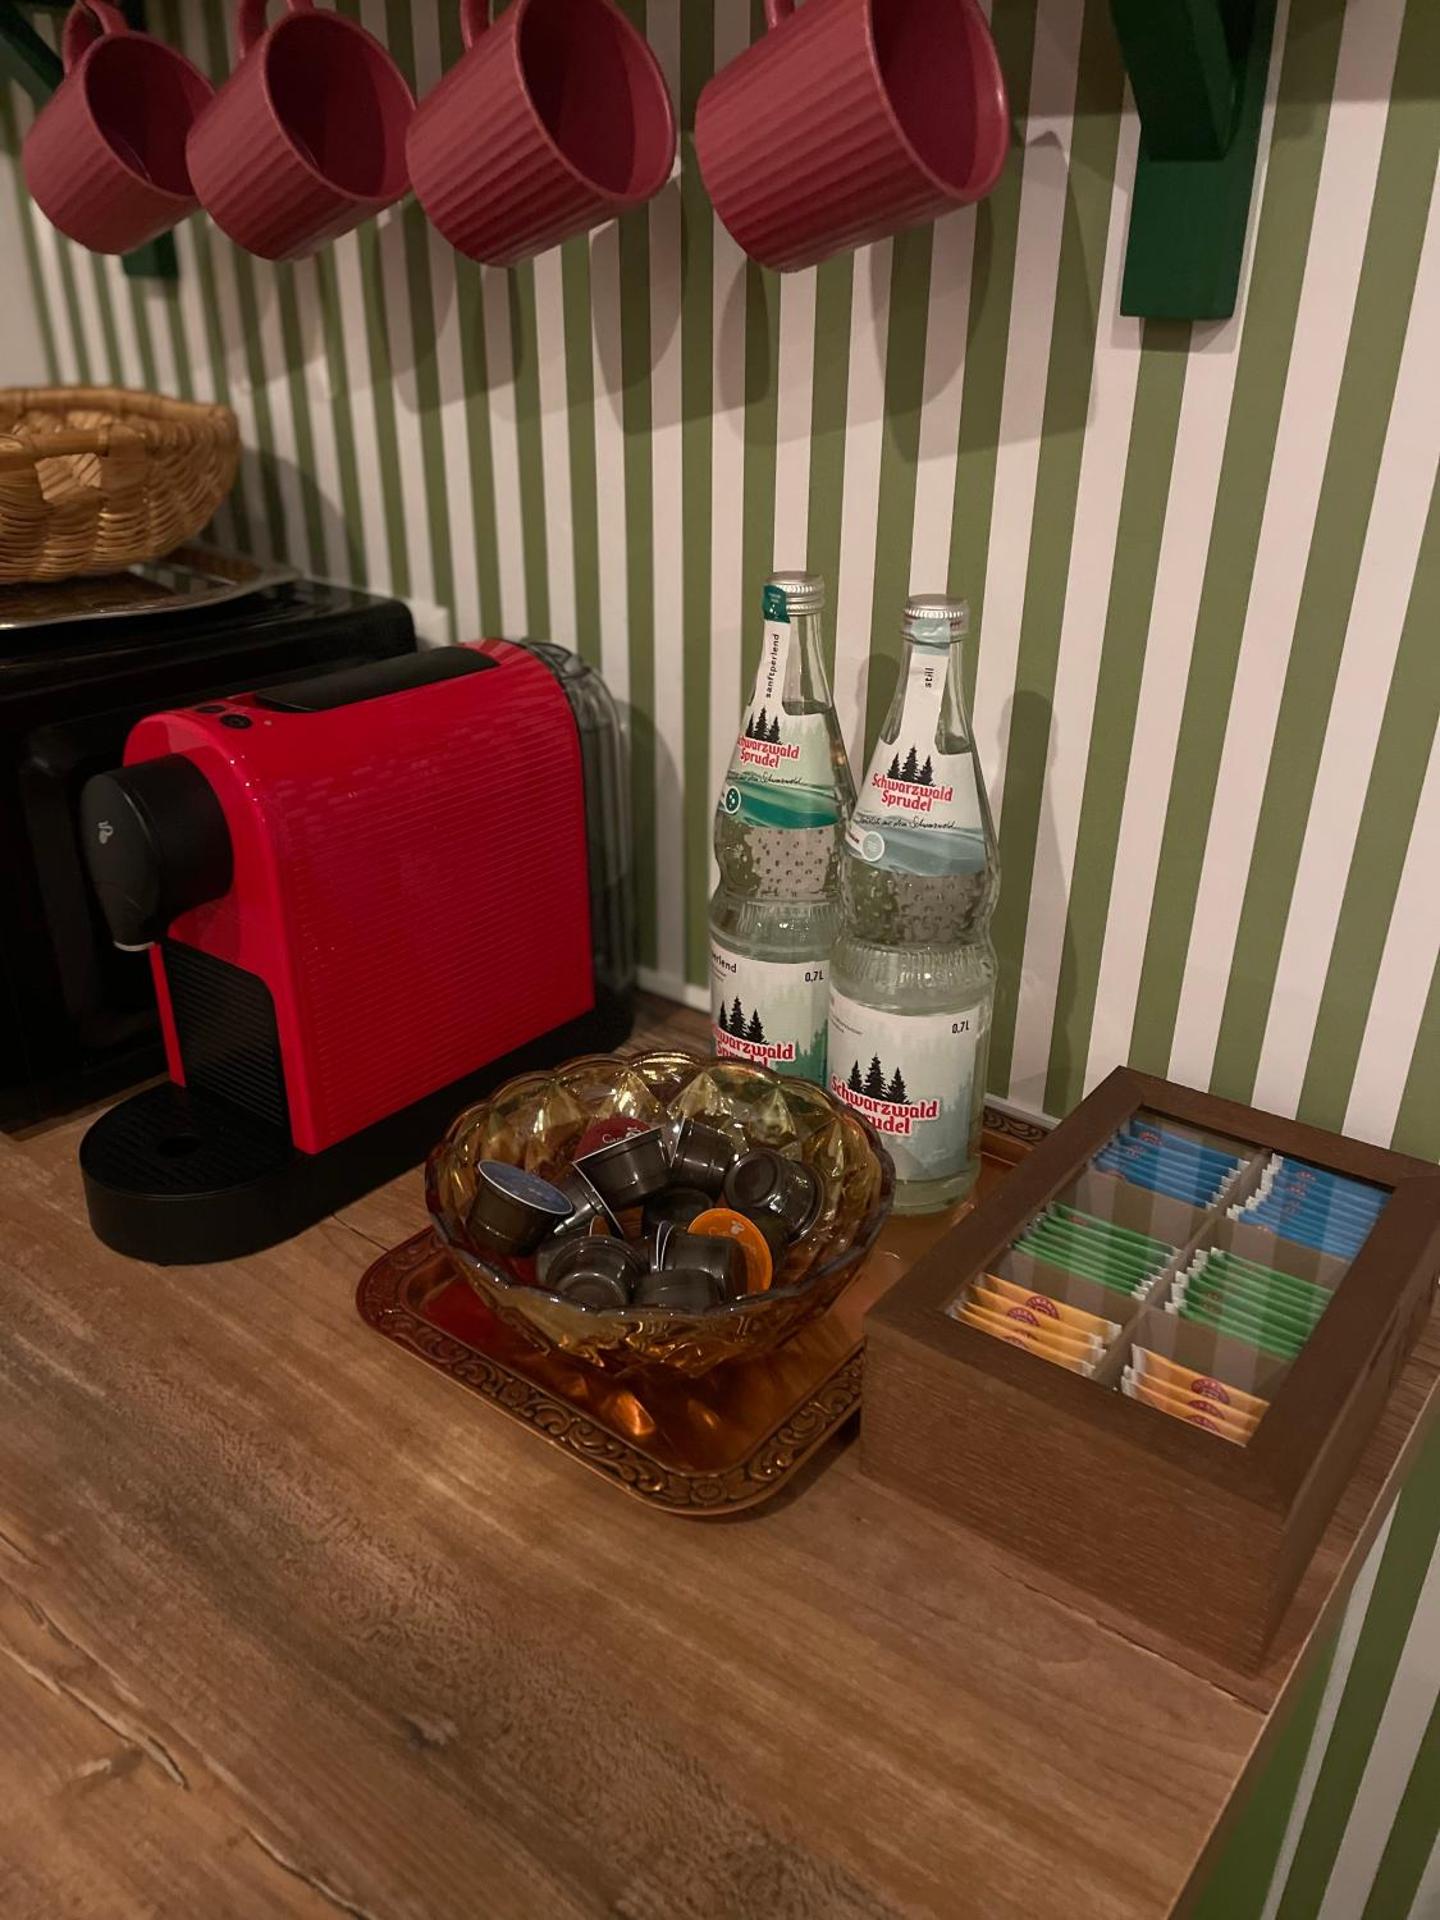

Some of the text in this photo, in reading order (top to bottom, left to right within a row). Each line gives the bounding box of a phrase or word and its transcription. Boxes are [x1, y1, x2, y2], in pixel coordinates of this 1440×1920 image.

[766, 633, 780, 699] sanftperlend
[925, 667, 934, 688] still
[740, 747, 780, 768] Sprudel
[872, 772, 953, 802] Schwarzwald
[881, 789, 932, 812] Sprudel
[831, 1075, 938, 1119] Schwarzwald
